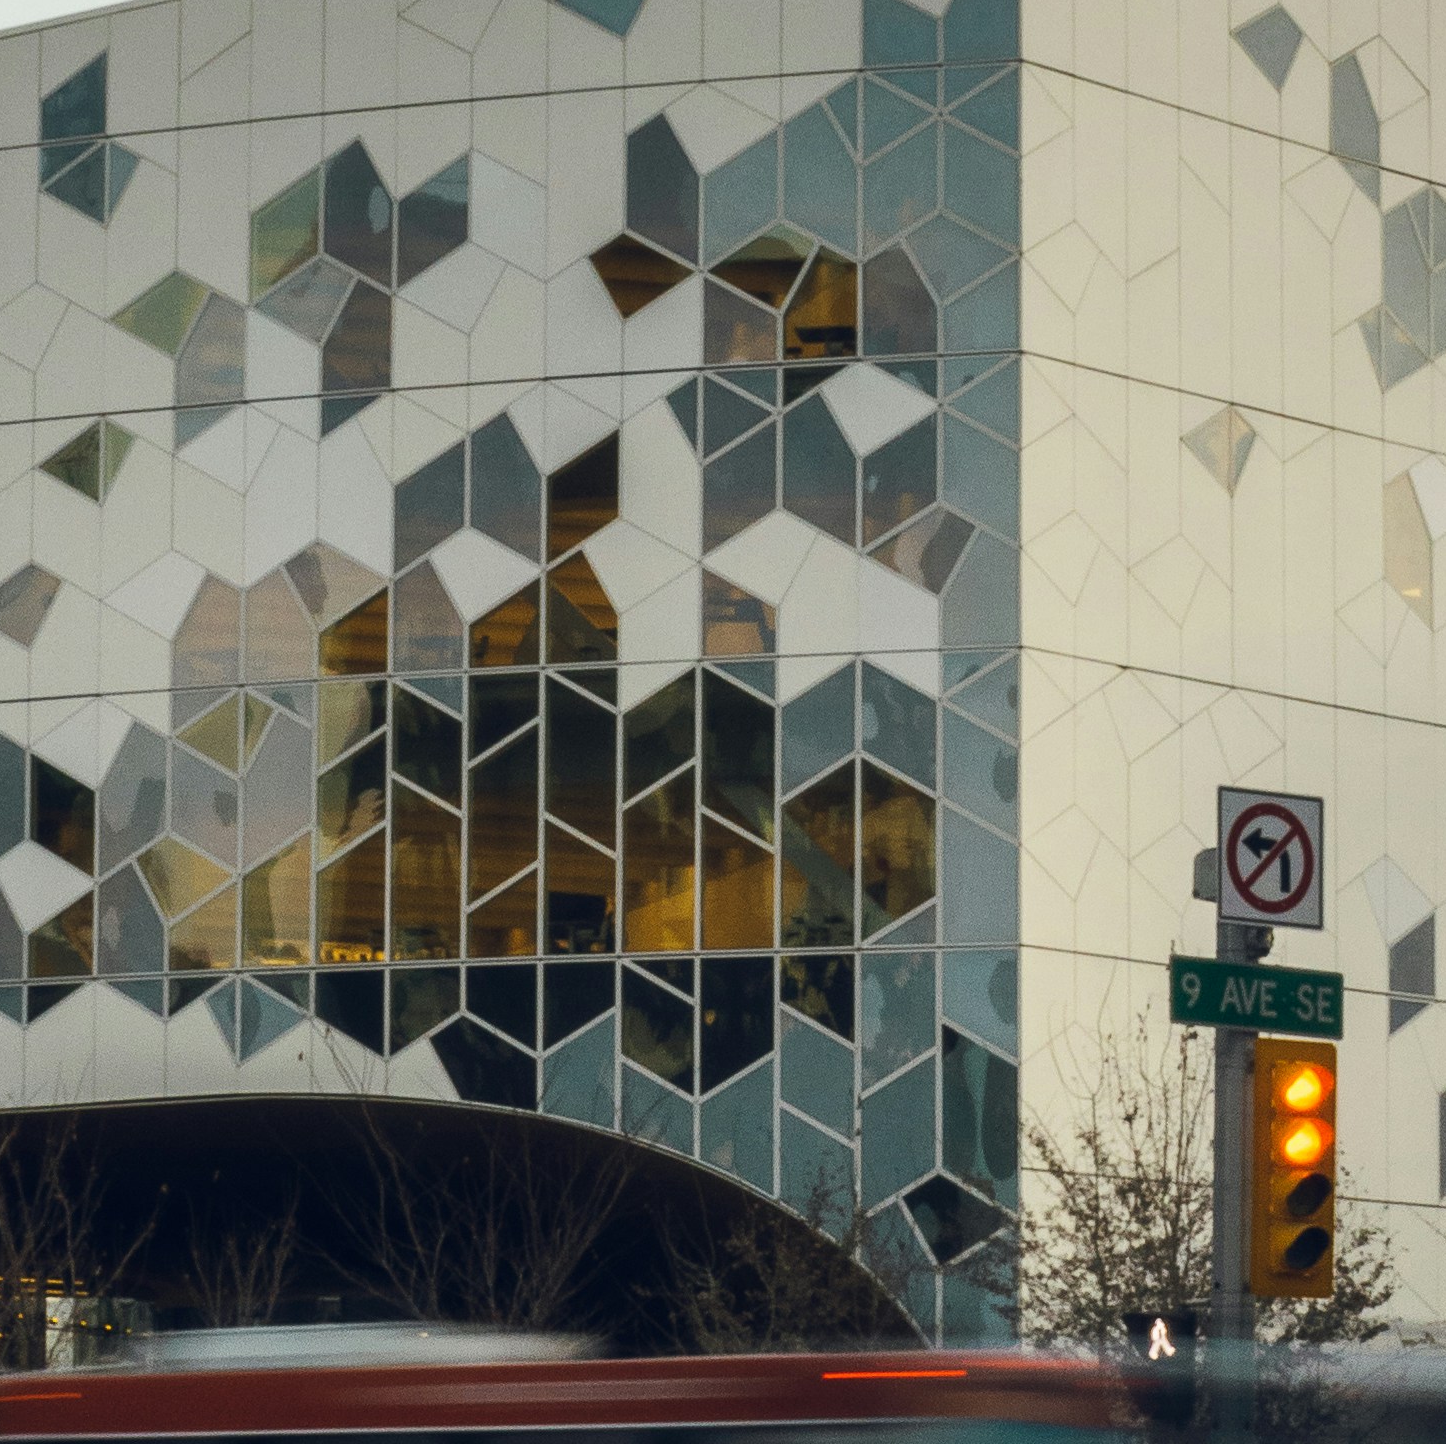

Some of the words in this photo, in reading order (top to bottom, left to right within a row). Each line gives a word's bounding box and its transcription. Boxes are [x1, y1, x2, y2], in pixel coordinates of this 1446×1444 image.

[1181, 972, 1201, 1009] 9
[1220, 977, 1277, 1018] AVE
[1297, 984, 1334, 1023] SE
